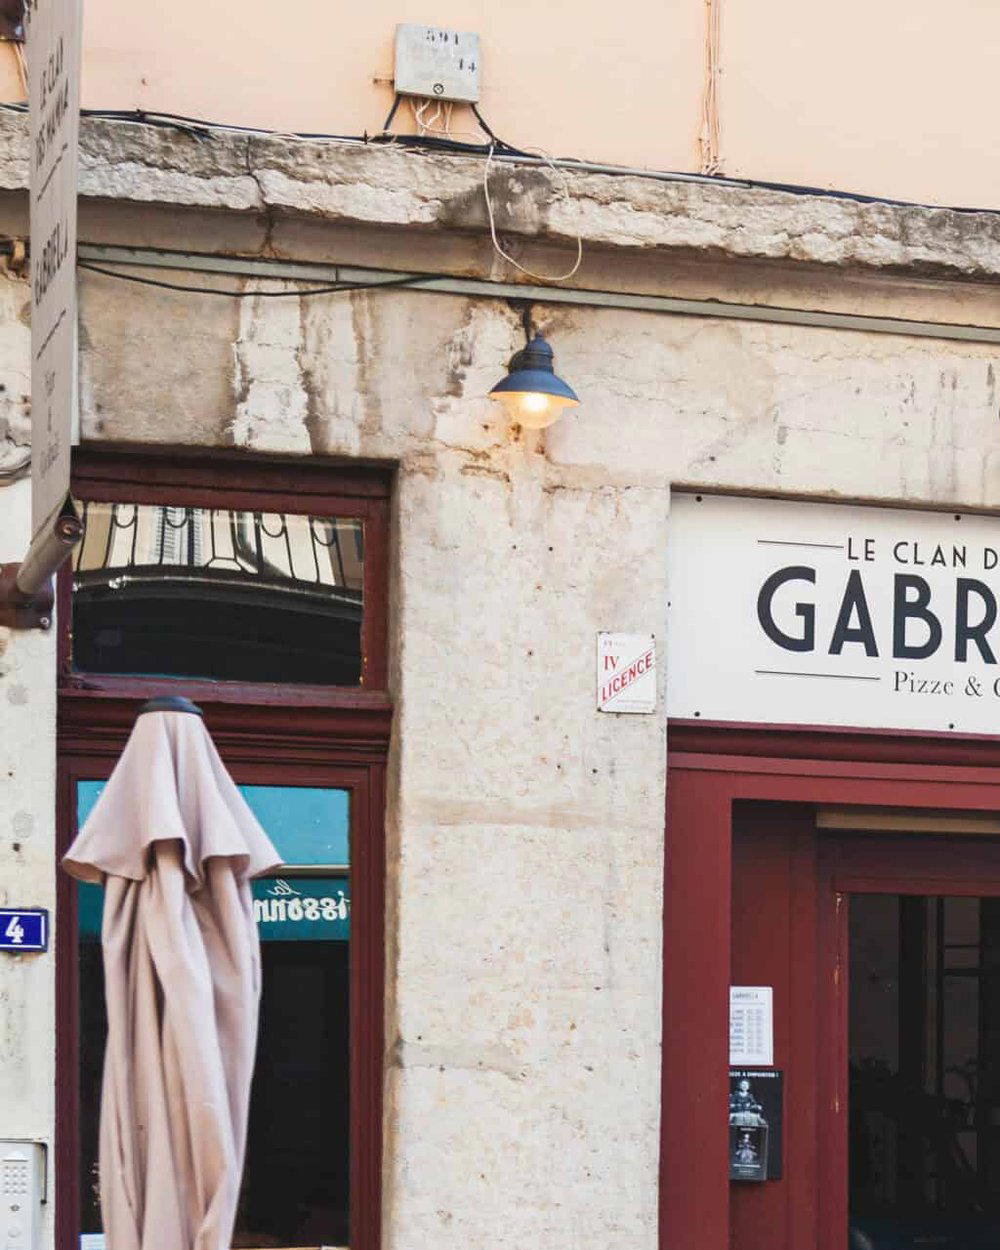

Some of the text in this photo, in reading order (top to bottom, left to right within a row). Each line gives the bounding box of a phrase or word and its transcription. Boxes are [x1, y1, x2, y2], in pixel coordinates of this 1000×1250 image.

[846, 536, 877, 563] LE
[892, 540, 968, 569] CLAN
[601, 650, 654, 702] LICENCE
[603, 655, 619, 672] IV
[892, 669, 955, 697] Pizze
[964, 676, 983, 698] &
[5, 916, 24, 944] 4
